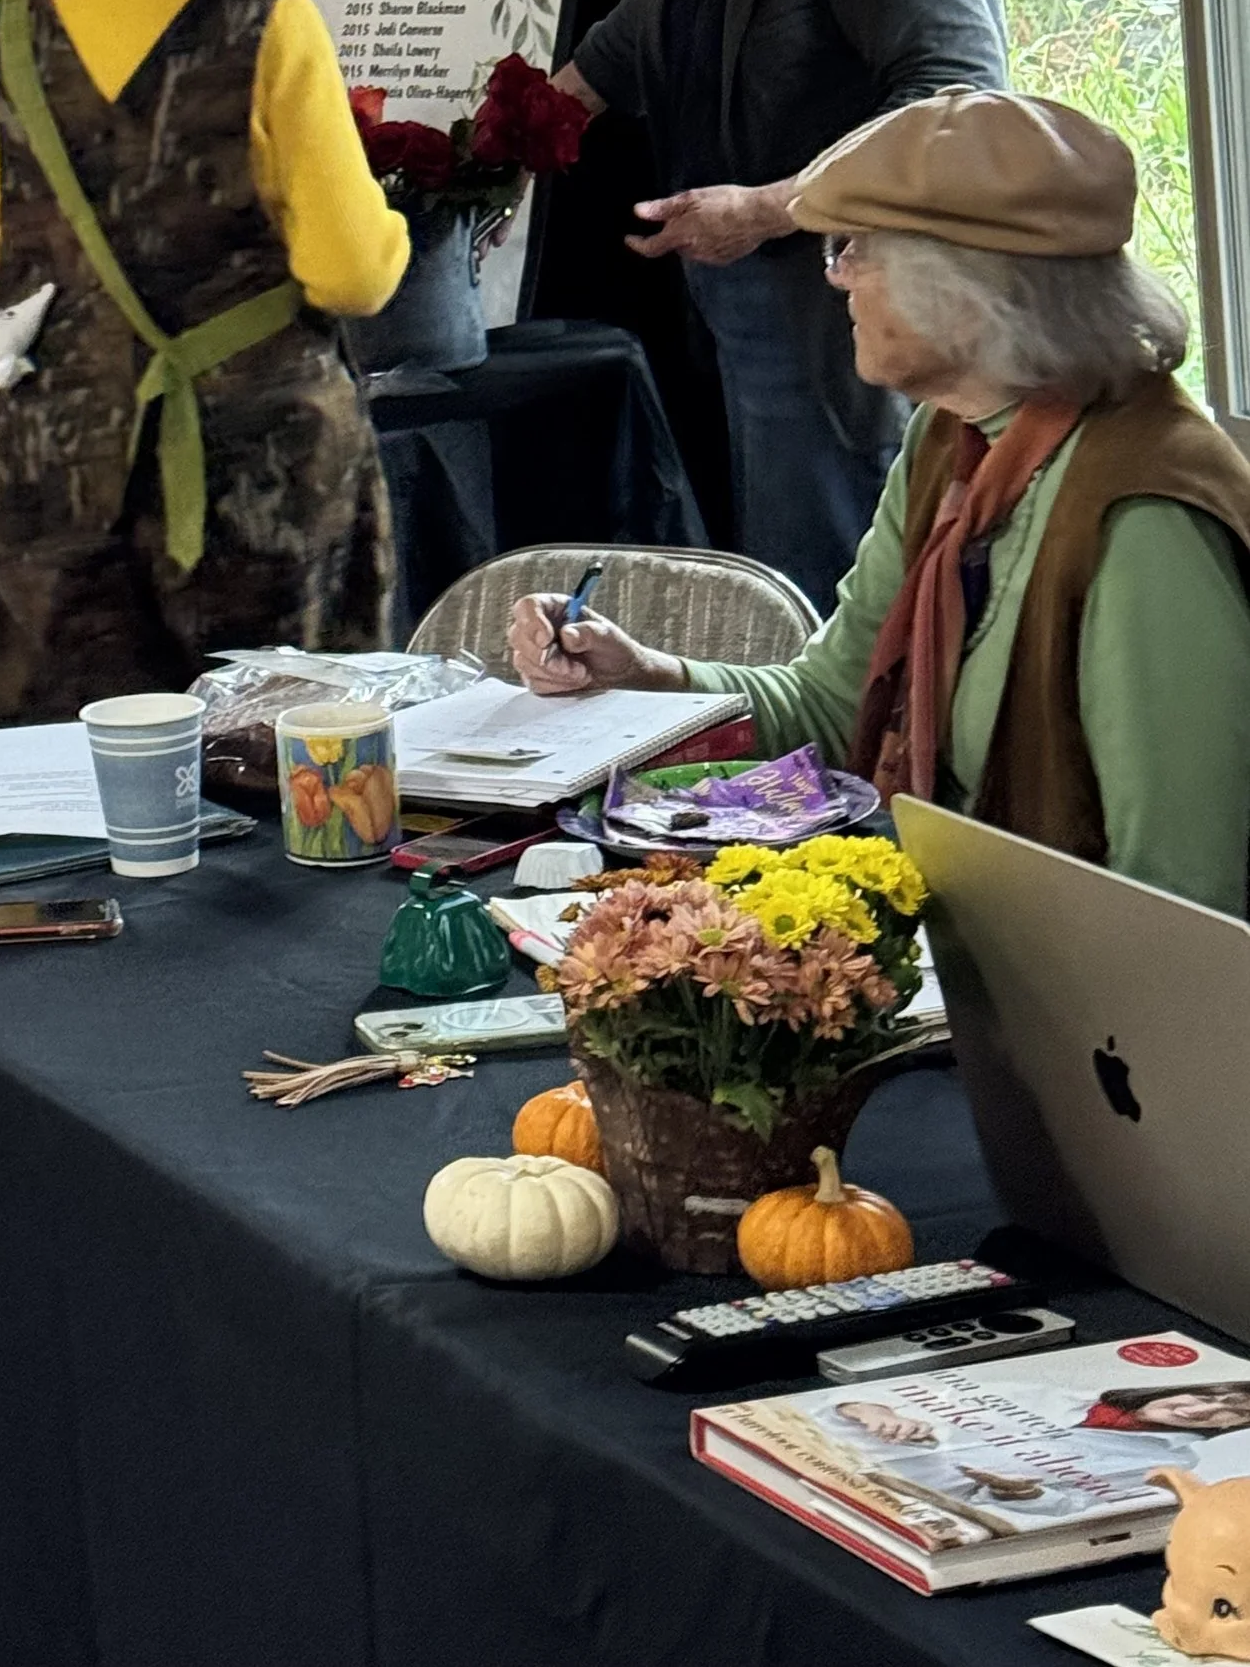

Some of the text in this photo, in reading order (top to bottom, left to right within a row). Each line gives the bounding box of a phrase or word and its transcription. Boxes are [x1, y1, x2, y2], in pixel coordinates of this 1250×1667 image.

[345, 1, 466, 16] 2015 Sharon Blackman
[342, 23, 370, 36] 2015
[374, 22, 397, 36] Jodi
[338, 42, 441, 61] 2015 Sheila Lowery
[928, 1368, 1073, 1440] ina garten
[891, 1385, 1159, 1503] make it ahead
